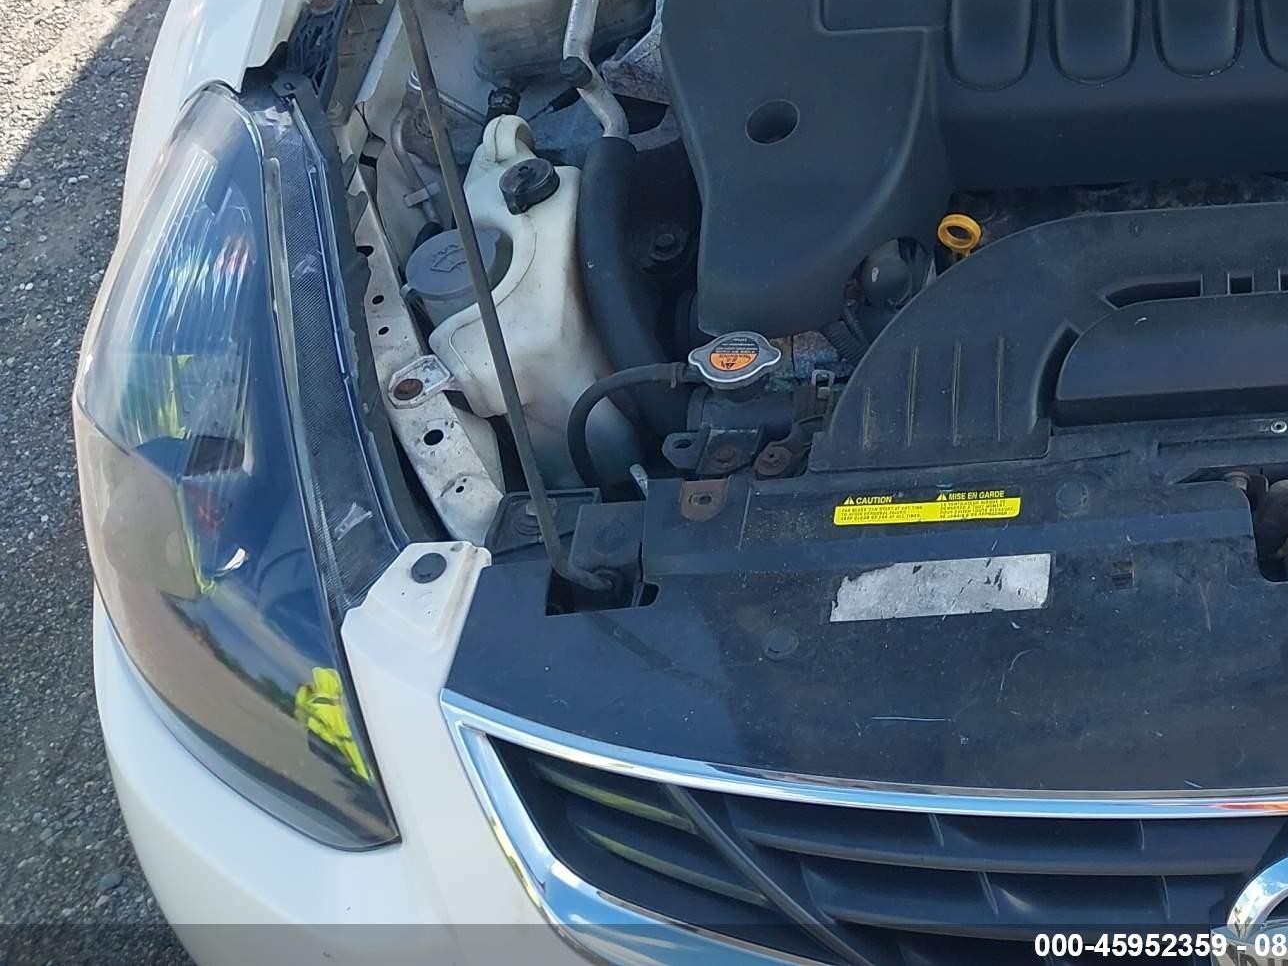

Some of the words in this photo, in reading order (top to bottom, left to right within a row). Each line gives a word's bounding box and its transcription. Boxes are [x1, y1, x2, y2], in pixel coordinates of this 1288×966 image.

[948, 492, 966, 500] MISE
[967, 491, 978, 500] EN
[978, 490, 1005, 499] GARDE
[855, 496, 893, 505] CAUTION
